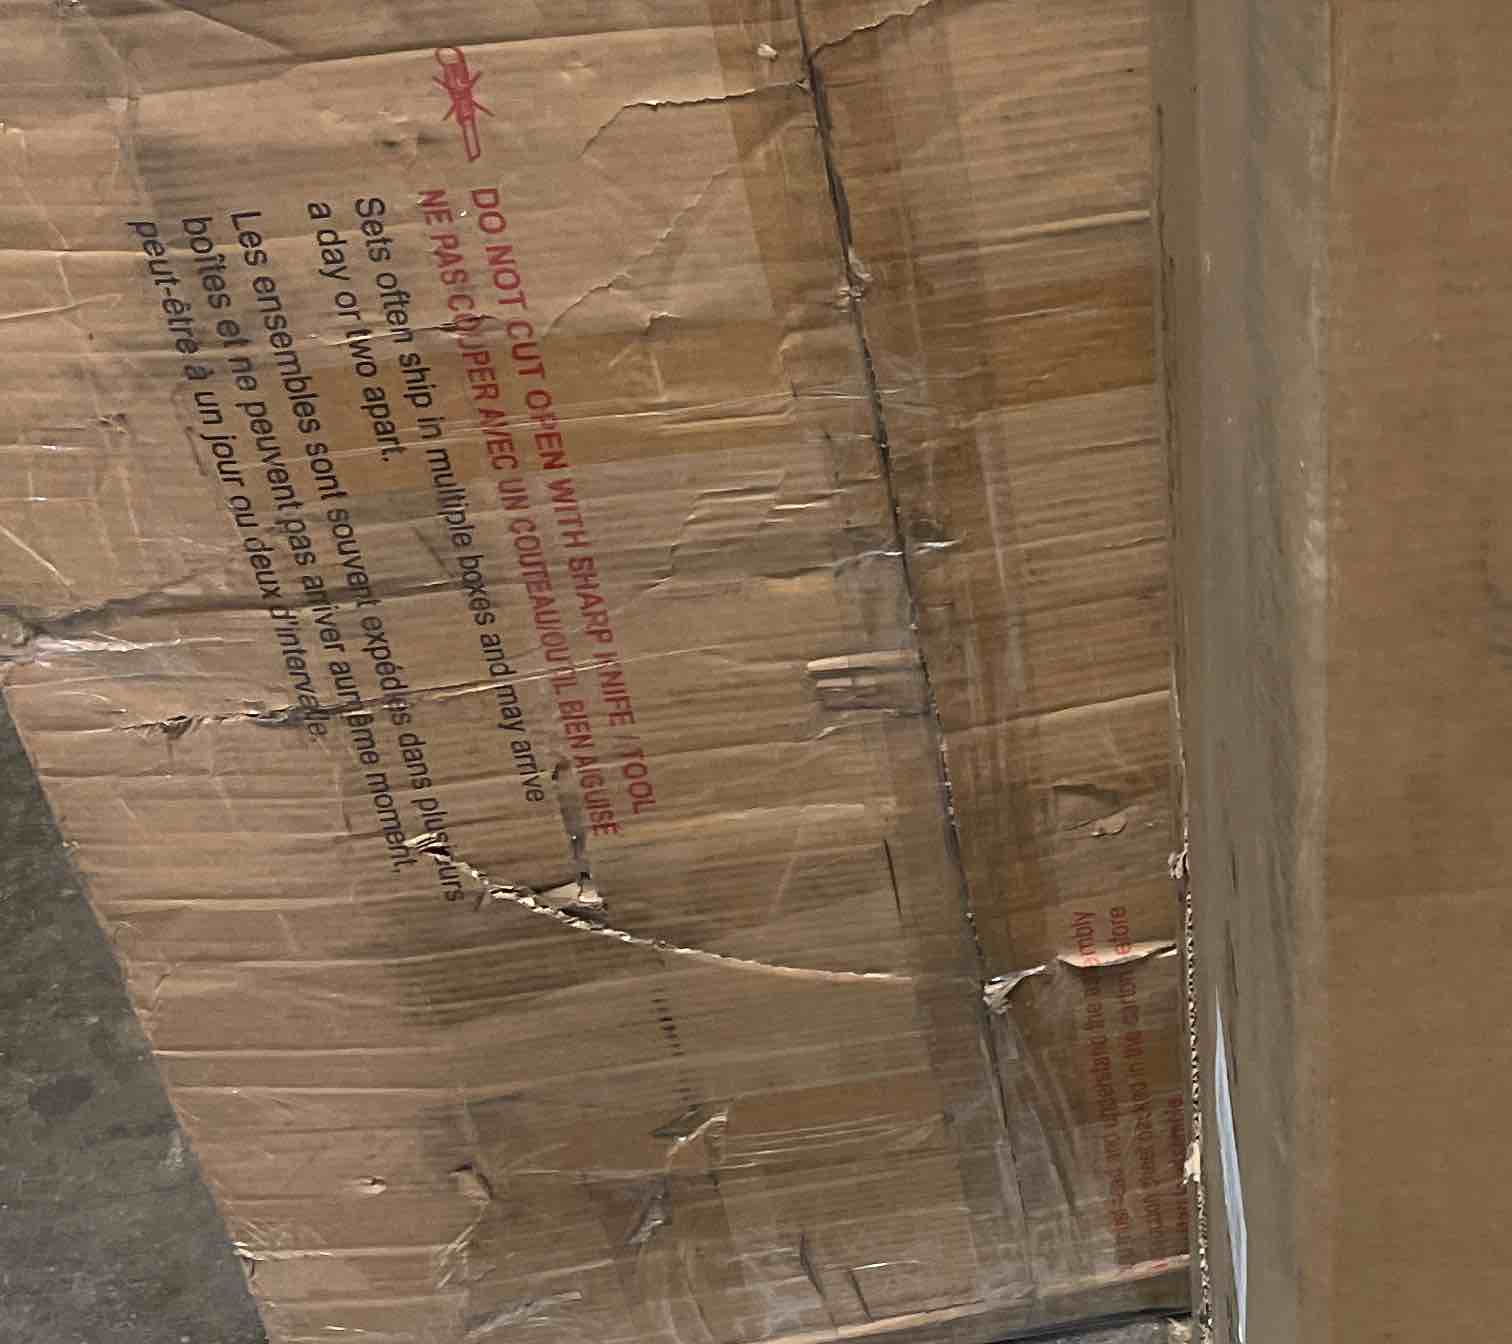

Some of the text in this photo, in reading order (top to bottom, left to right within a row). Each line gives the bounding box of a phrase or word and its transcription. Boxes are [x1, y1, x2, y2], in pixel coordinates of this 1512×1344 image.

[417, 189, 453, 225] NE
[471, 187, 506, 234] DO
[127, 221, 199, 354] peut-être
[430, 234, 470, 286] PAS
[486, 244, 527, 310] NOT
[216, 319, 252, 348] et
[307, 202, 406, 462] a day or two apart.
[505, 319, 546, 379] CUT
[184, 364, 214, 380] à
[228, 356, 257, 391] ne
[194, 392, 223, 424] un
[526, 390, 570, 470] OPEN
[200, 433, 245, 486] jour
[236, 401, 303, 510] peuvent
[478, 408, 518, 470] AVEC
[230, 211, 268, 266] Les
[252, 276, 321, 434] ensembles
[306, 442, 347, 500] sont
[327, 509, 381, 608] souvent
[398, 733, 432, 790] dans
[230, 495, 258, 527] ou
[355, 197, 547, 803] Sets often ship in multiple boxes and may arrive
[498, 479, 529, 511] UN
[547, 478, 592, 548] WITH
[243, 537, 282, 600] deux
[275, 519, 316, 566] pas
[568, 557, 614, 643] SHARP
[558, 698, 595, 753] BIEN
[621, 747, 657, 815] TOOL
